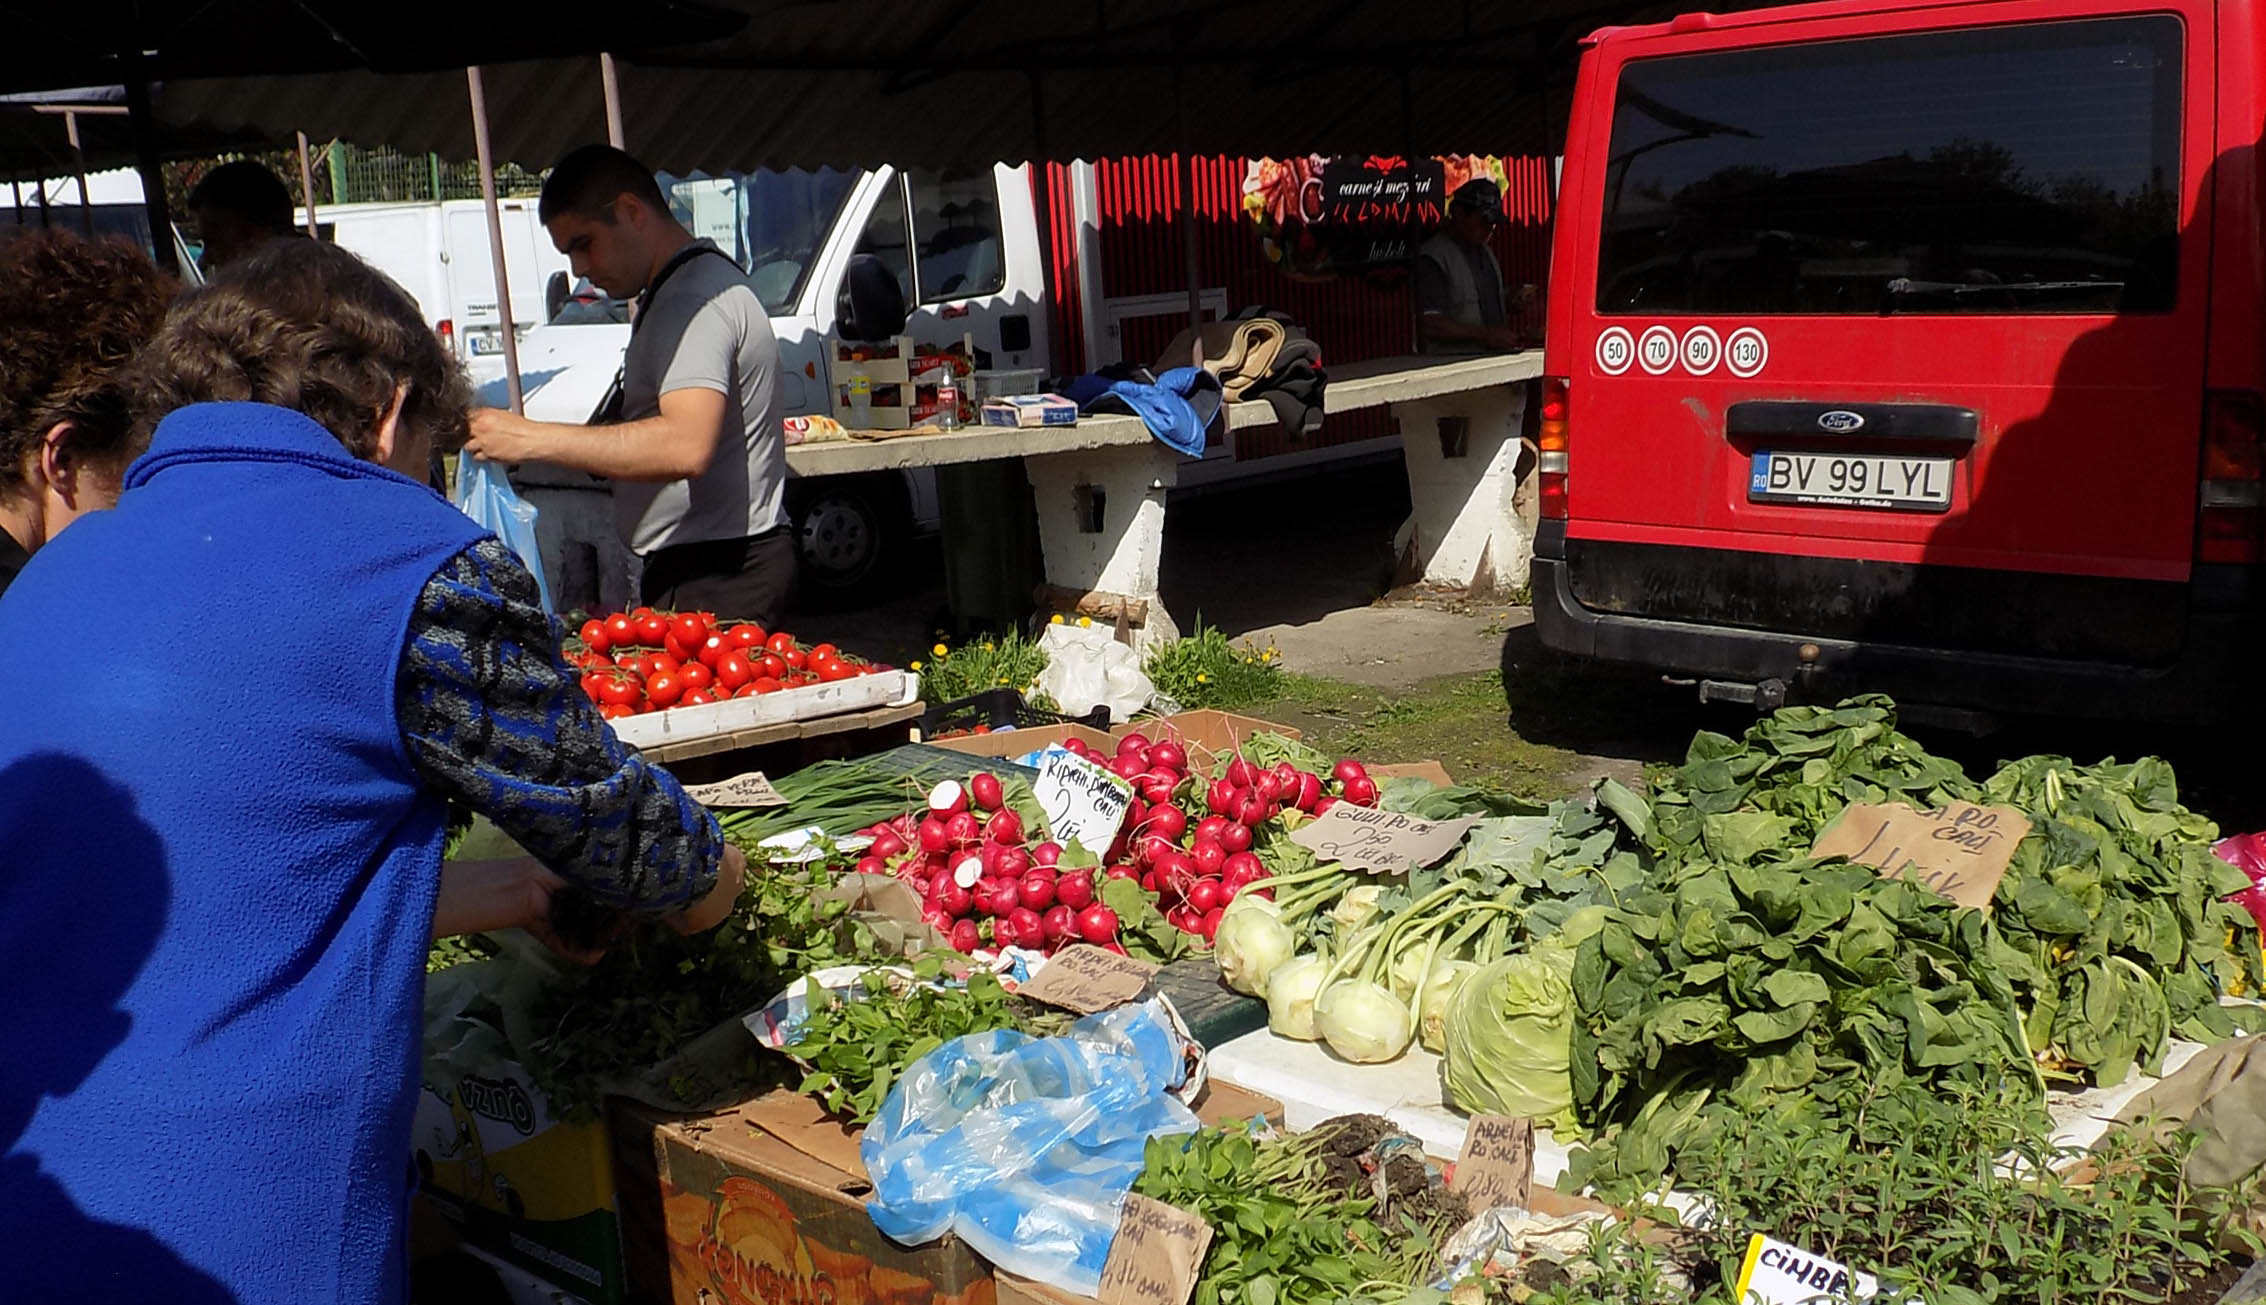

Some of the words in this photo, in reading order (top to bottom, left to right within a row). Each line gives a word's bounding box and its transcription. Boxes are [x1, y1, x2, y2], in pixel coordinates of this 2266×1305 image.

[1608, 341, 1623, 360] 50
[1650, 341, 1666, 360] 70
[1692, 341, 1709, 360] 90
[1735, 343, 1758, 362] 130
[1769, 456, 1816, 490] BV
[1828, 459, 1868, 493] 99
[1876, 461, 1941, 498] LYL
